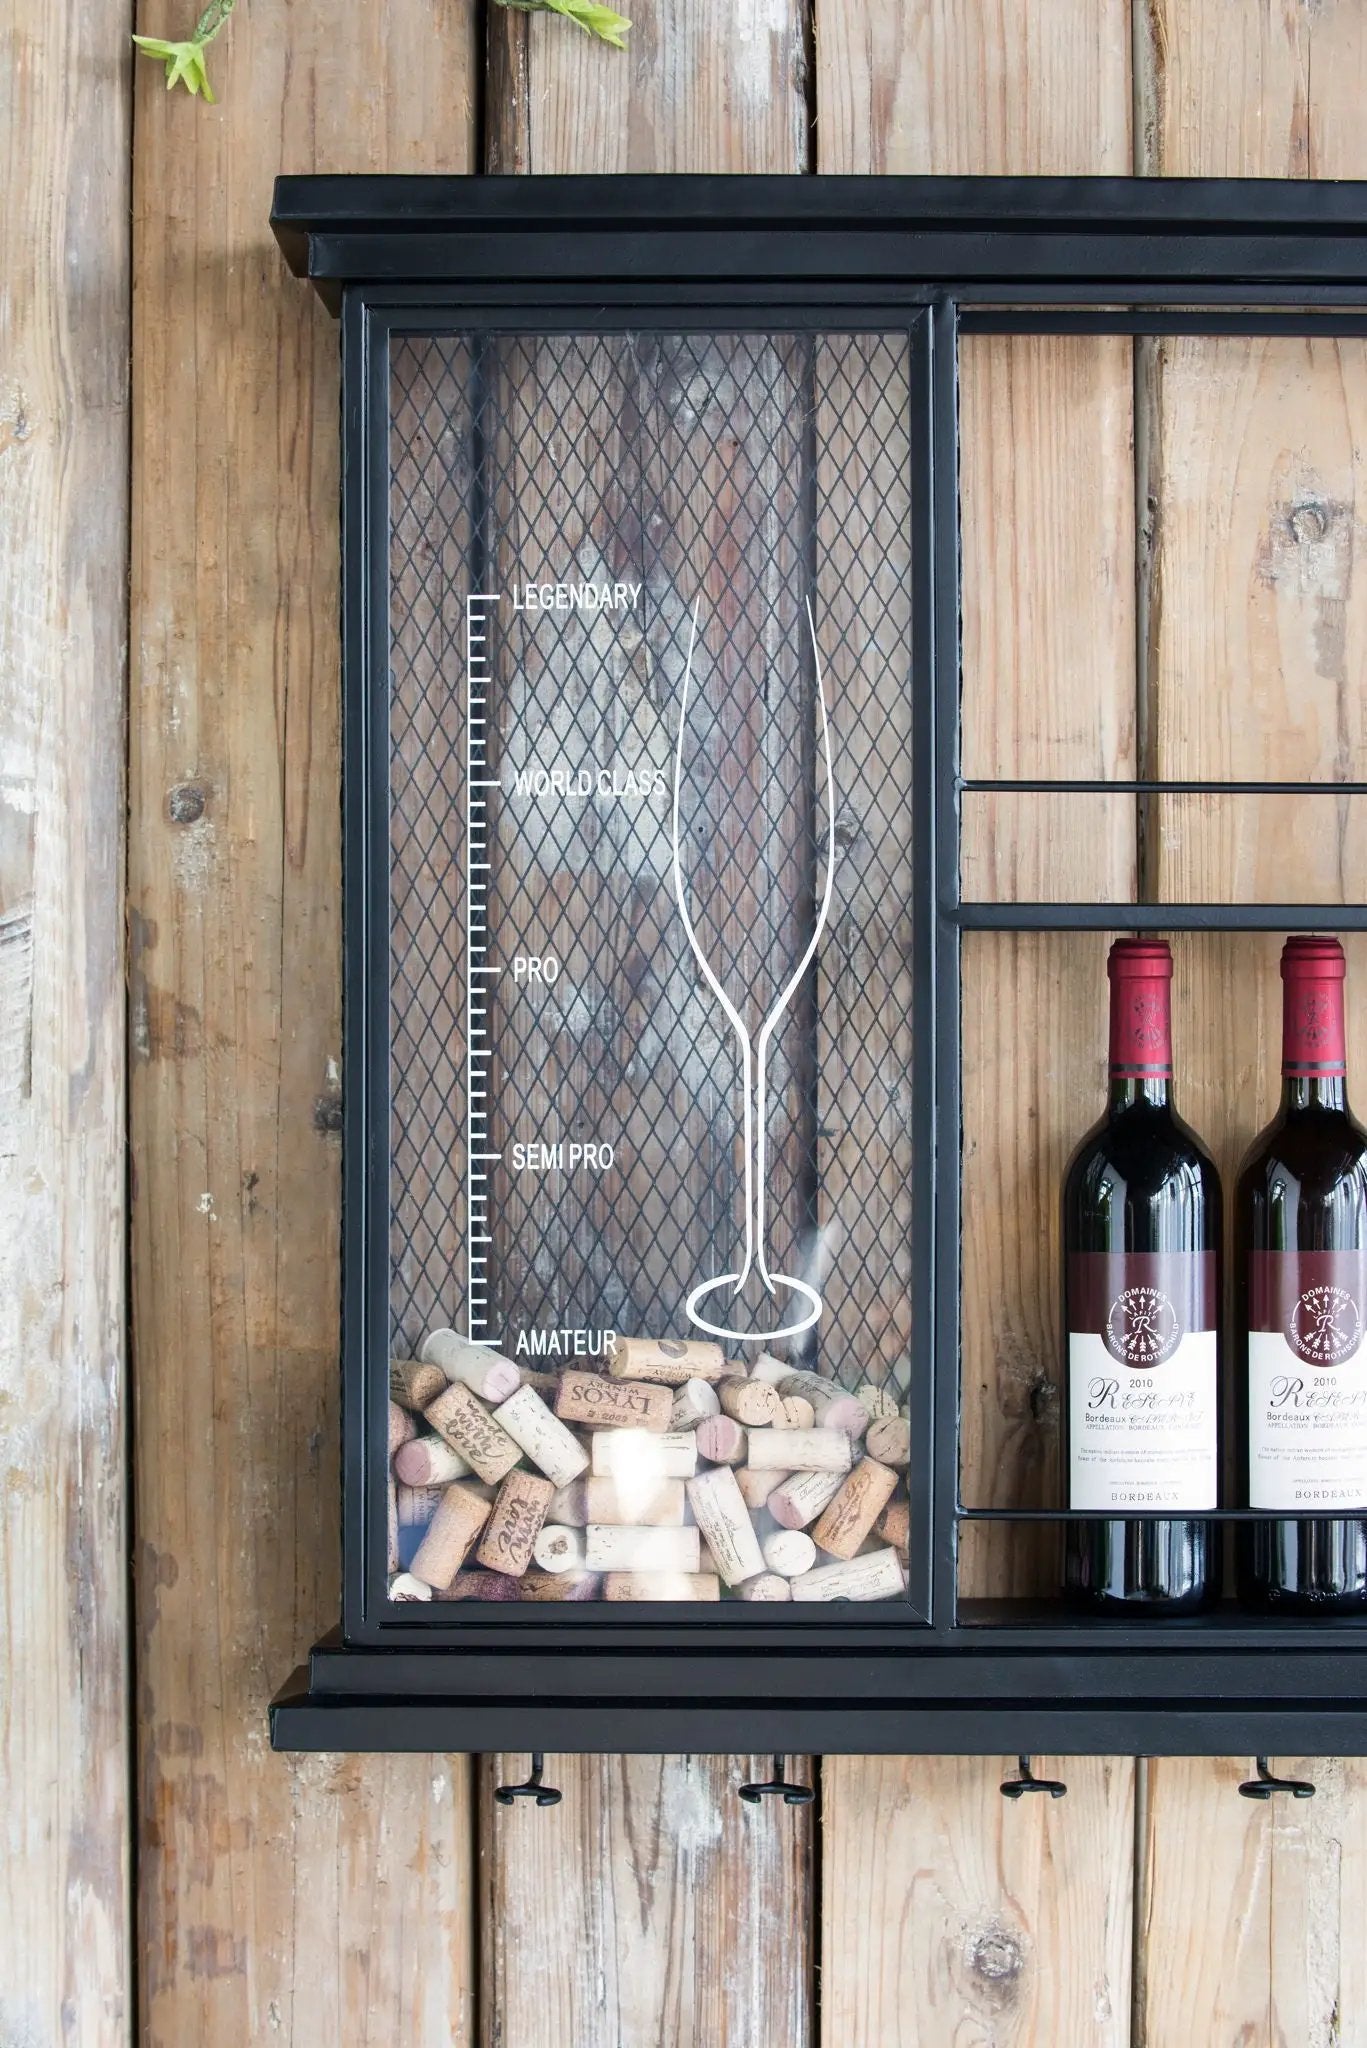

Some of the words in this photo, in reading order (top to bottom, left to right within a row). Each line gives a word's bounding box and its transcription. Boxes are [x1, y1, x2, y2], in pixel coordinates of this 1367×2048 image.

[513, 583, 643, 610] LEGENDARY
[514, 769, 592, 798] WORLD
[598, 768, 666, 797] CLASS
[514, 956, 559, 983] PRO
[512, 1143, 563, 1170] SEMI
[569, 1143, 615, 1170] PRO
[1118, 1287, 1168, 1302] DOMAINES
[1301, 1286, 1351, 1302] DOMAINES
[515, 1329, 618, 1356] AMATEUR
[1106, 1323, 1128, 1357] BARONS
[1128, 1353, 1140, 1362] DE
[1141, 1323, 1179, 1362] ROTHSCHILD
[1289, 1322, 1312, 1355] BARONS
[1311, 1352, 1323, 1360] DE
[587, 1380, 640, 1395] WINERY
[1129, 1378, 1154, 1389] 2010
[1313, 1377, 1337, 1387] 2010
[571, 1385, 651, 1416] LYKOS
[1085, 1412, 1126, 1423] Bordeaux
[1266, 1411, 1311, 1421] Bordeaux
[444, 1418, 488, 1465] love
[1111, 1491, 1179, 1501] BORDEAUX
[1295, 1488, 1362, 1499] BORDEAUX
[498, 1498, 529, 1553] love
